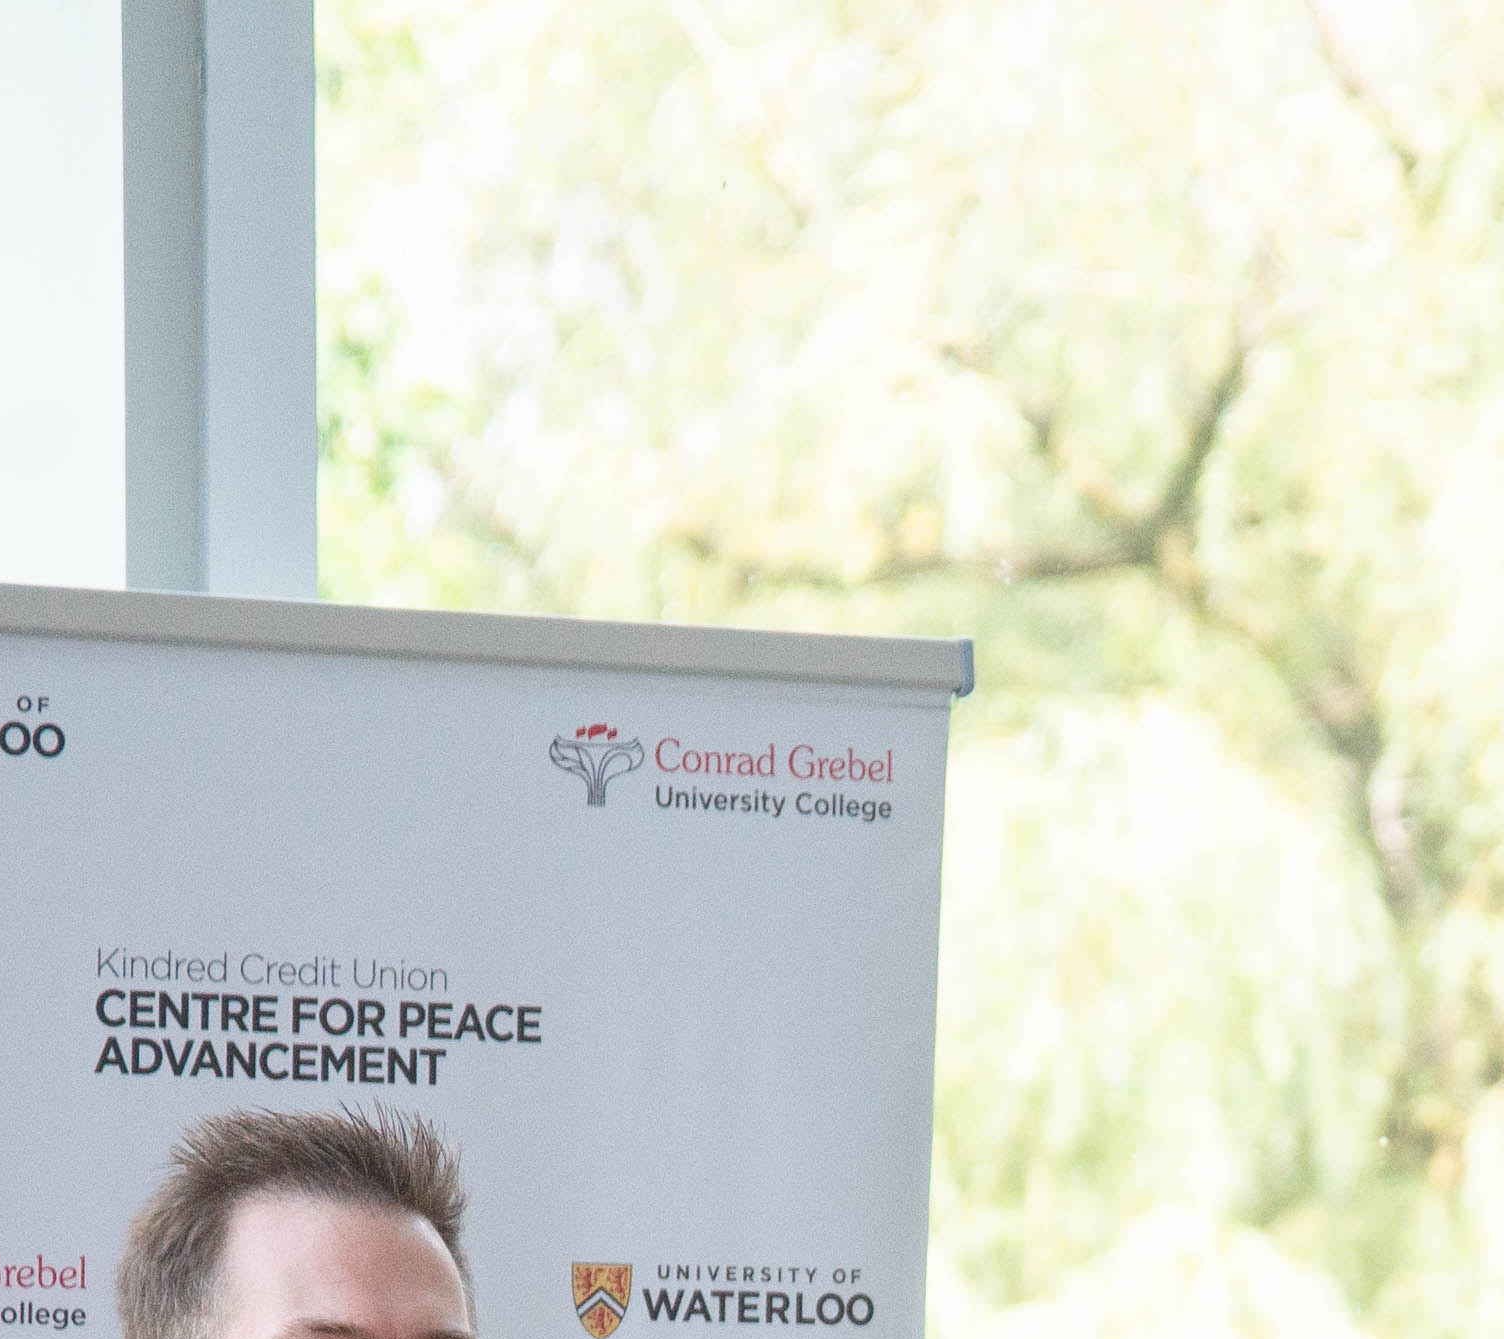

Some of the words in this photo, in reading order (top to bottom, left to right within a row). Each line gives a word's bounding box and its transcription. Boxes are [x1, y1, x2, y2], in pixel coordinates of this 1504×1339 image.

[16, 695, 51, 714] OF
[654, 737, 776, 777] Conrad
[788, 744, 894, 783] Grebel
[655, 785, 786, 818] University
[795, 792, 893, 822] College
[96, 947, 228, 984] Kindred
[240, 953, 341, 988] Credit
[352, 959, 449, 993] Union
[95, 988, 279, 1034] CENTRE
[291, 996, 387, 1038] FOR
[399, 1001, 543, 1043] PEACE
[94, 1035, 447, 1086] ADVANCEMENT
[657, 1264, 818, 1284] UNIVERSITY
[832, 1267, 862, 1284] OF
[642, 1288, 875, 1326] WATERLOO
